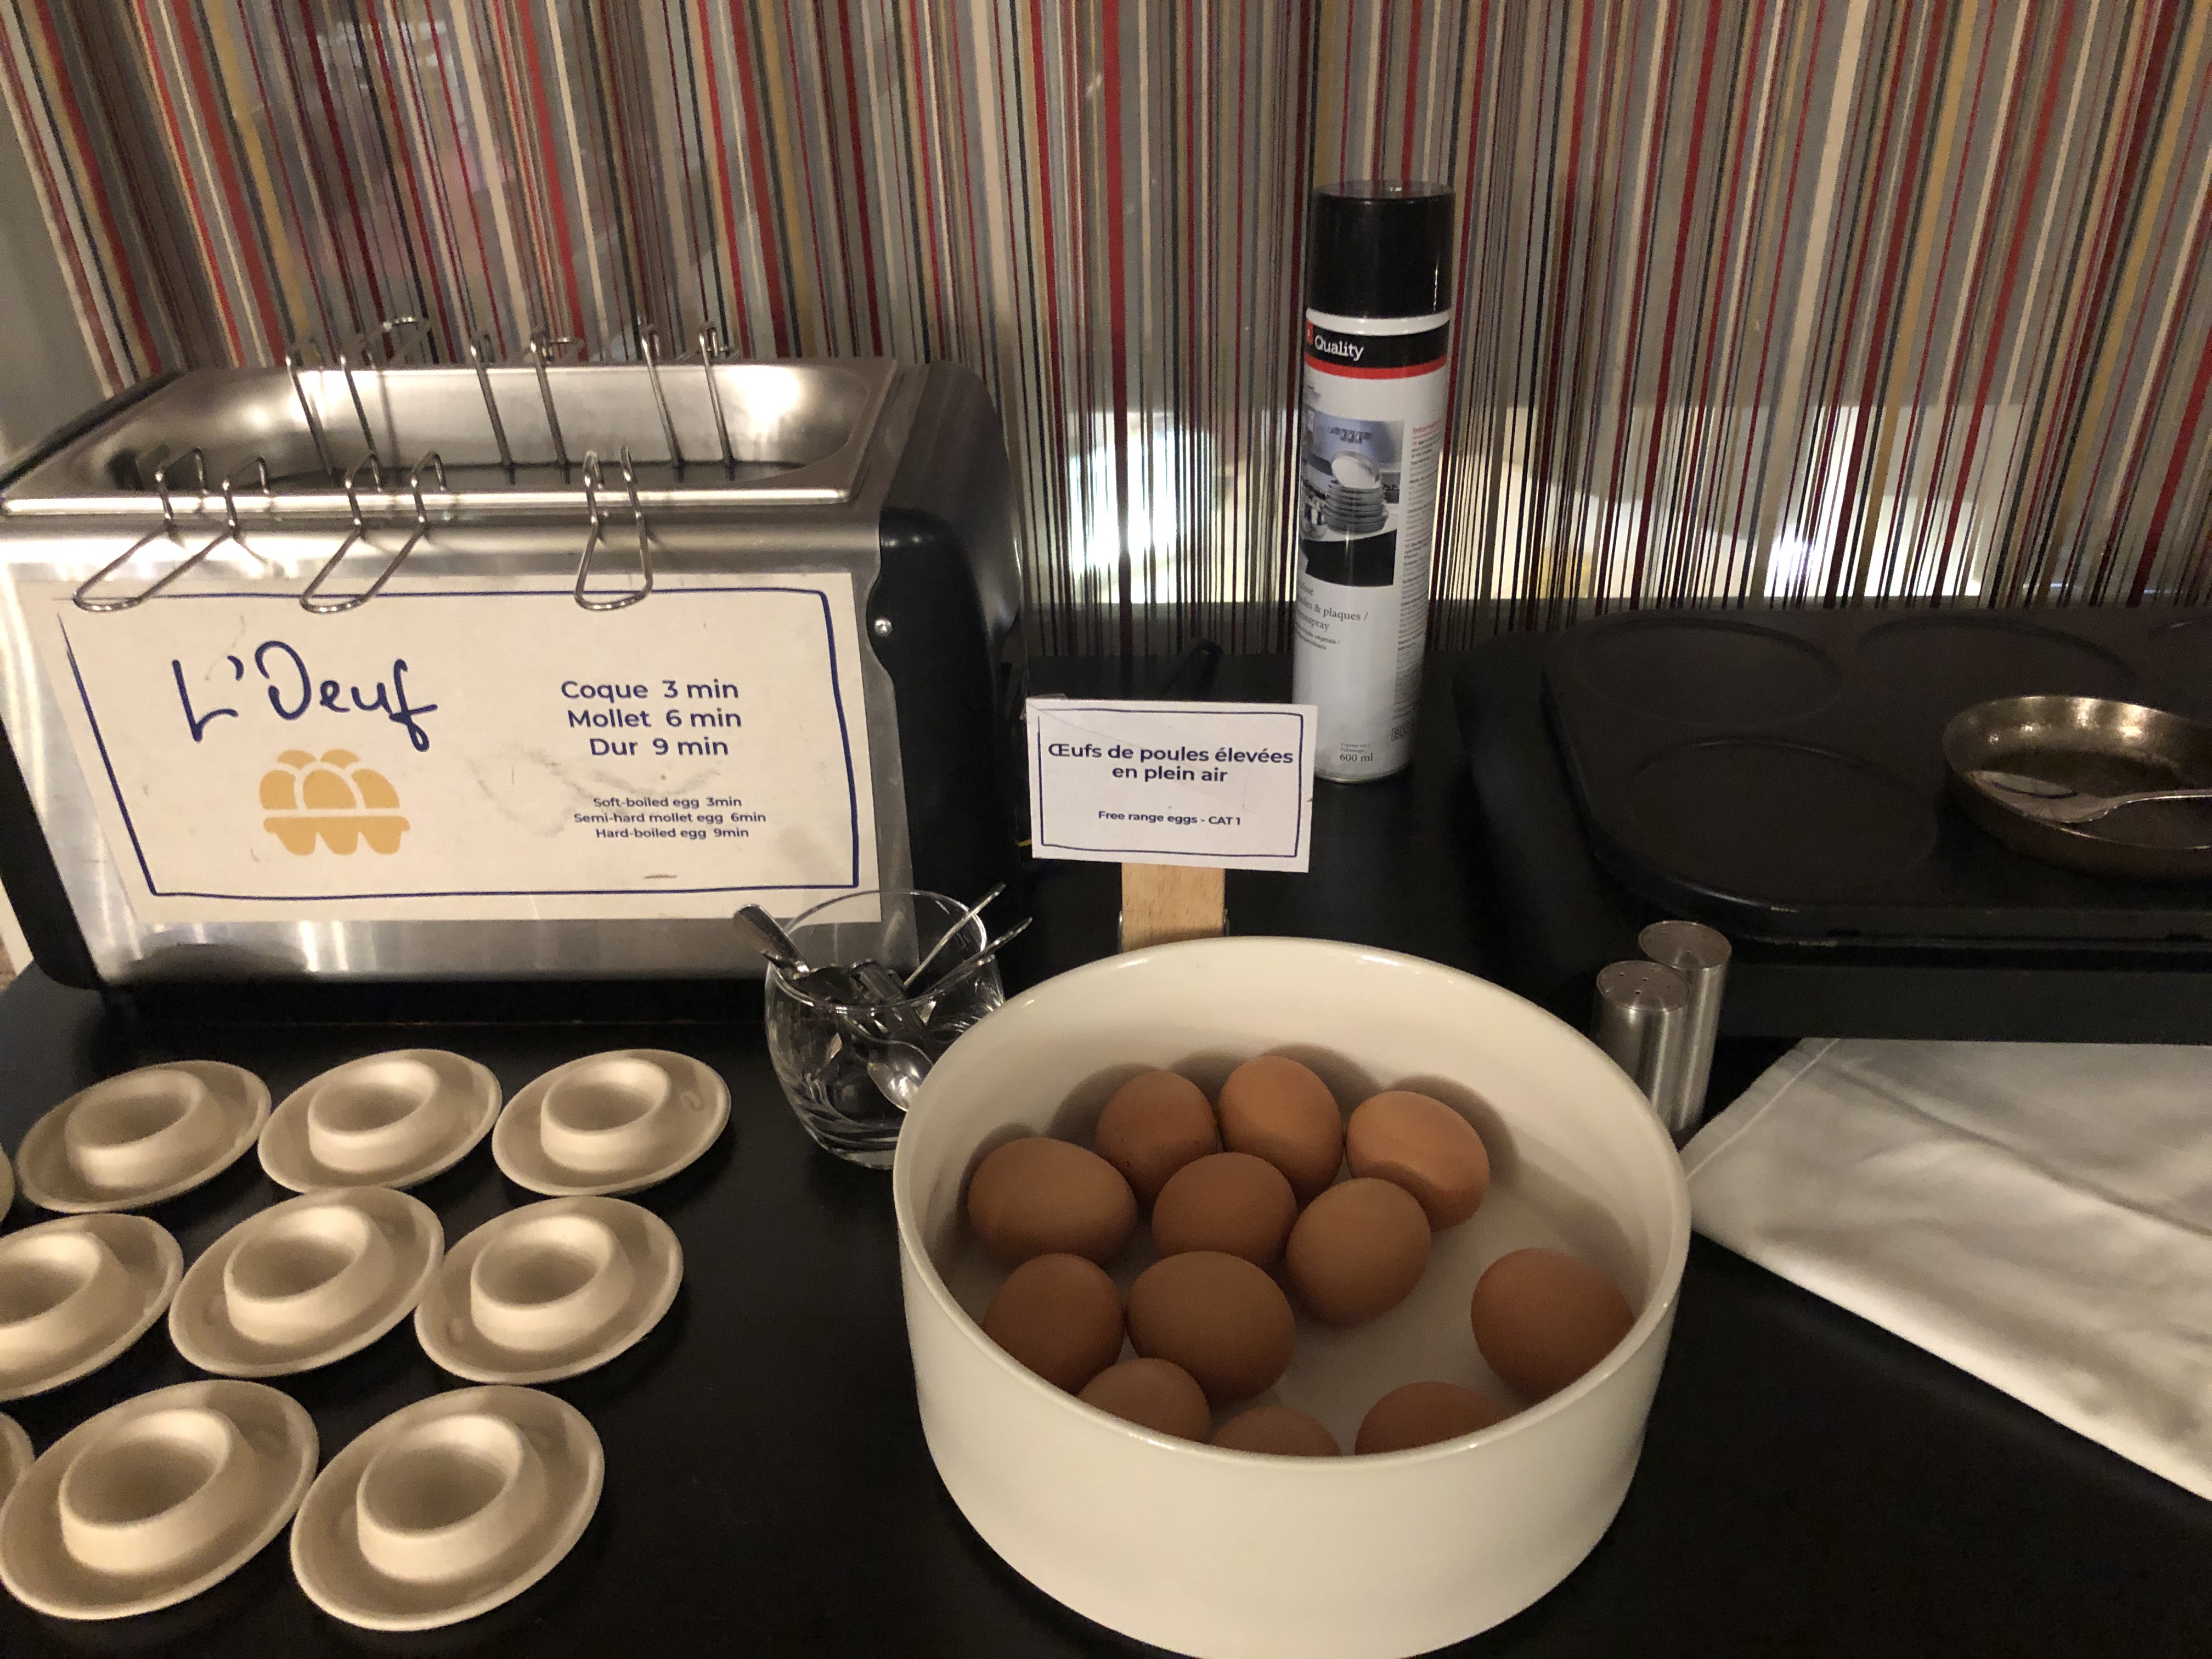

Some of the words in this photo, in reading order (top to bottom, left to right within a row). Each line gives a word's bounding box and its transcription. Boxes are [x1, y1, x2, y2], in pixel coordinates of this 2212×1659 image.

[1314, 334, 1364, 362] Quality
[1313, 603, 1322, 613] &
[1323, 607, 1361, 622] plaques
[1363, 611, 1369, 621] /
[561, 681, 648, 704] Coque
[662, 680, 678, 698] 3
[686, 679, 738, 699] min
[567, 708, 652, 727] Mollet
[666, 709, 682, 727] 6
[690, 708, 742, 727] min
[589, 738, 638, 756] Dur
[652, 738, 669, 755] 9
[677, 736, 729, 755] min
[1048, 743, 1102, 758] Œufs
[1107, 744, 1134, 759] de
[1140, 746, 1209, 763] poules
[1215, 747, 1293, 764] élevées
[1339, 754, 1358, 762] 600
[1361, 752, 1373, 762] ml
[1112, 768, 1137, 778] en
[1144, 765, 1194, 782] plein
[1201, 767, 1228, 782] air
[593, 797, 669, 807] Soft-boiled
[673, 799, 699, 809] egg
[706, 796, 742, 807] 3min
[574, 812, 645, 823] Semi-hard
[649, 812, 693, 822] mollet
[697, 815, 724, 825] egg
[730, 812, 766, 822] 6min
[1098, 811, 1125, 820] Free
[1128, 814, 1164, 823] range
[1167, 816, 1198, 825] eggs
[1208, 816, 1233, 825] CAT
[1235, 817, 1240, 826] 1
[596, 828, 676, 838] Hard-boiled
[680, 830, 707, 840] egg
[713, 828, 749, 837] 9min
